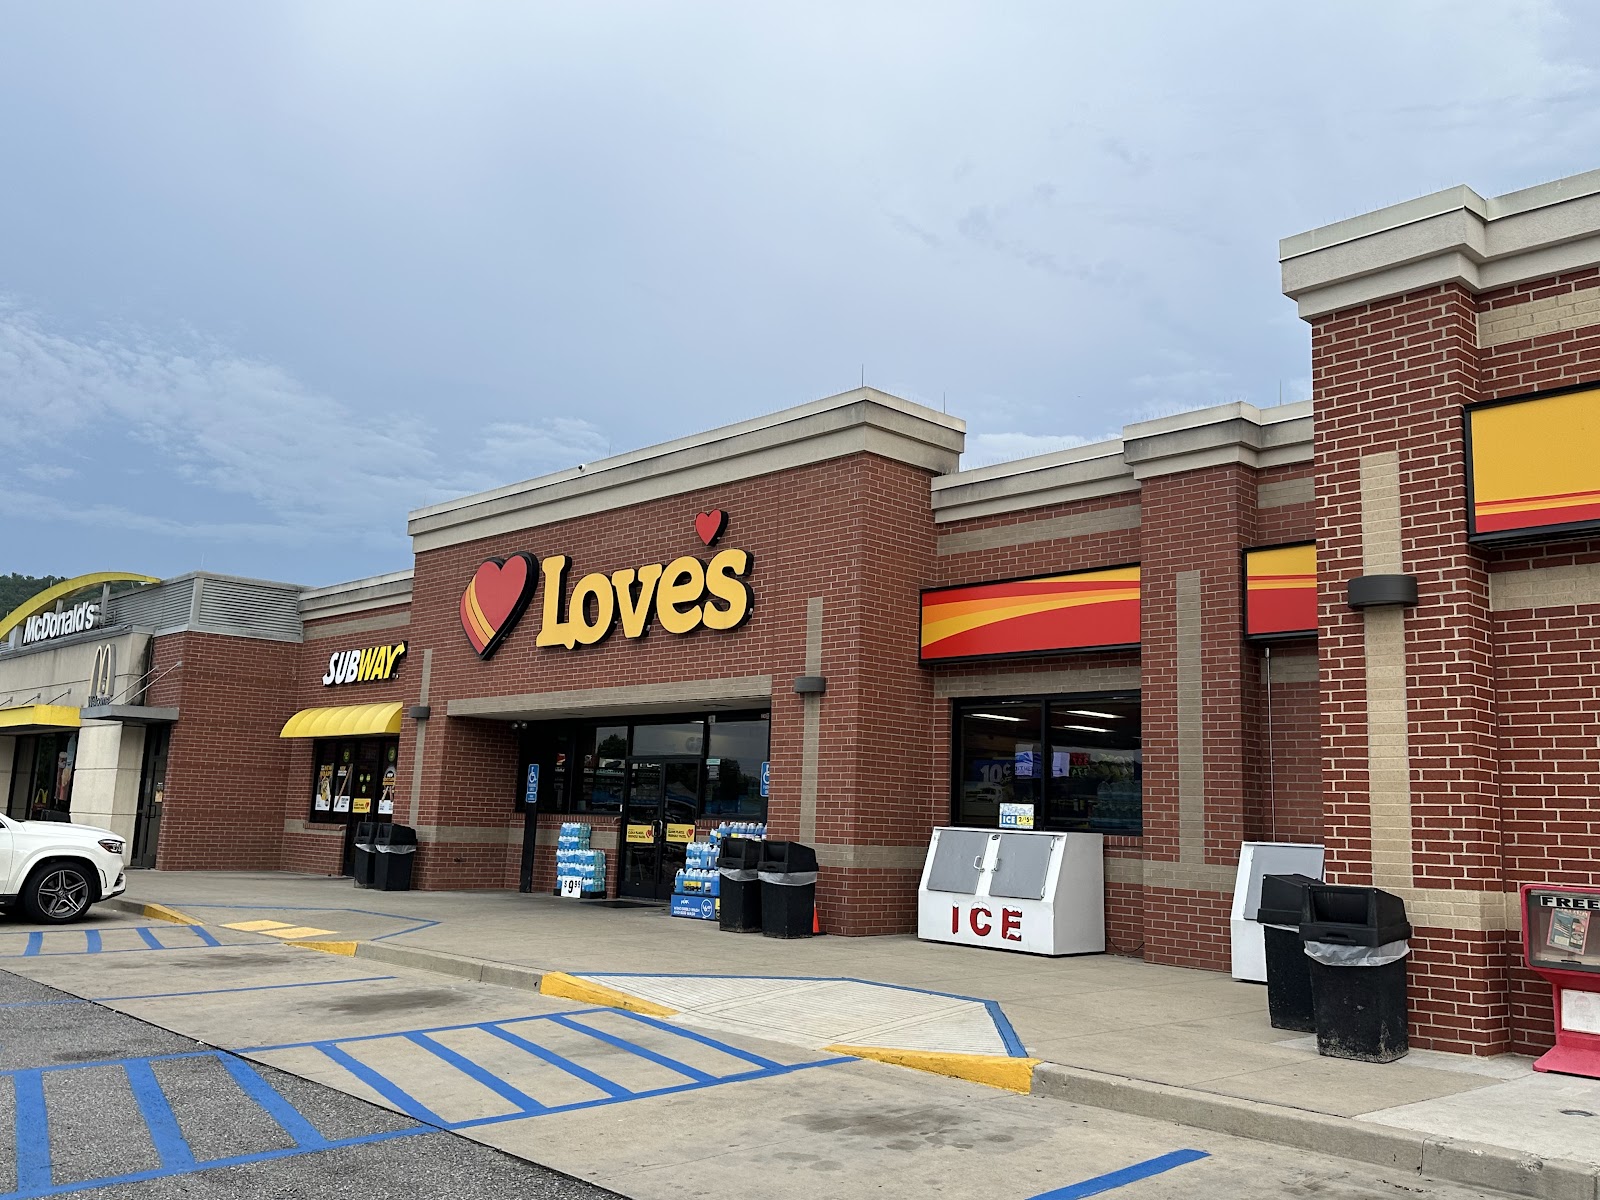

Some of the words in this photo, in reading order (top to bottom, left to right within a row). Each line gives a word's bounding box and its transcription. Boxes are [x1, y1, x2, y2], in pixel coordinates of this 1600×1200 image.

[23, 601, 95, 644] McDonald's
[322, 641, 405, 686] SUBWAY
[1003, 815, 1016, 824] ICE
[952, 901, 1022, 941] ICE
[1541, 896, 1600, 909] FREE
